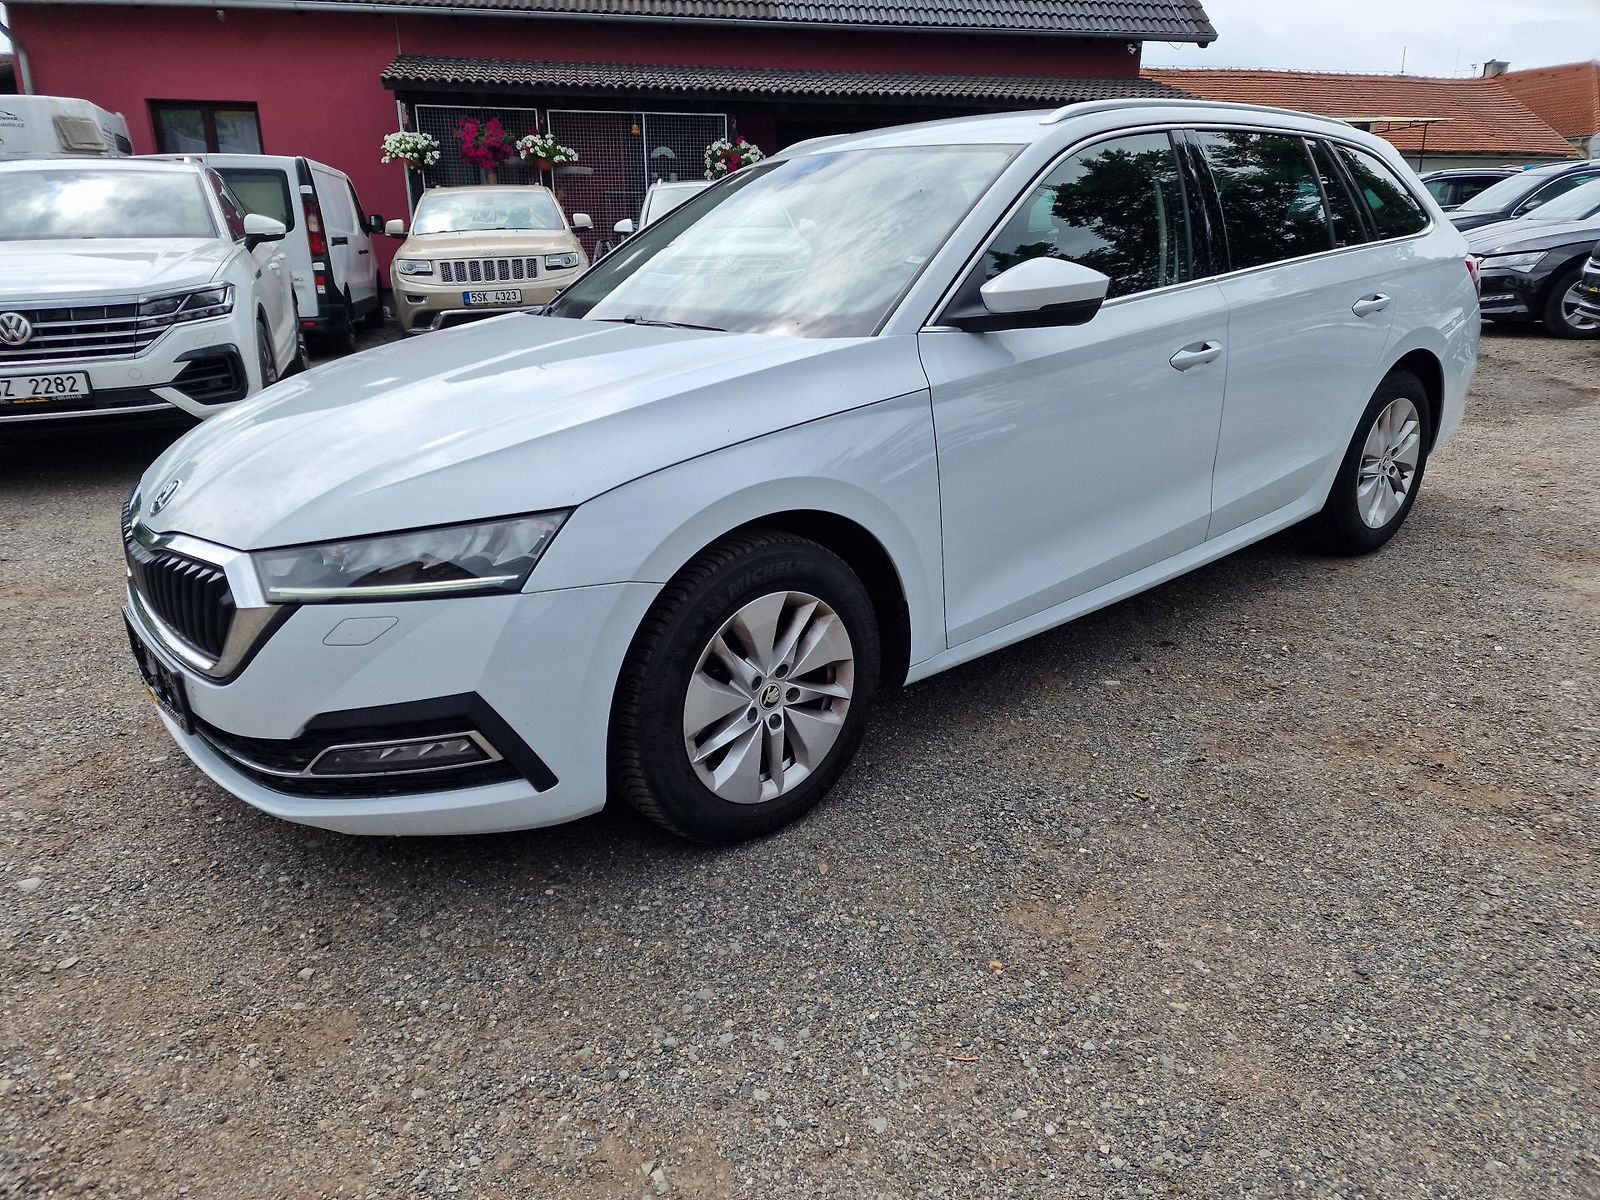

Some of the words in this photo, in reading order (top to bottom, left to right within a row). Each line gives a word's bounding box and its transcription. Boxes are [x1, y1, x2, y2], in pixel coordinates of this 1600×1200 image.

[471, 292, 489, 303] 5SK
[495, 291, 517, 301] 4323
[0, 379, 15, 397] Z
[29, 376, 78, 394] 2282
